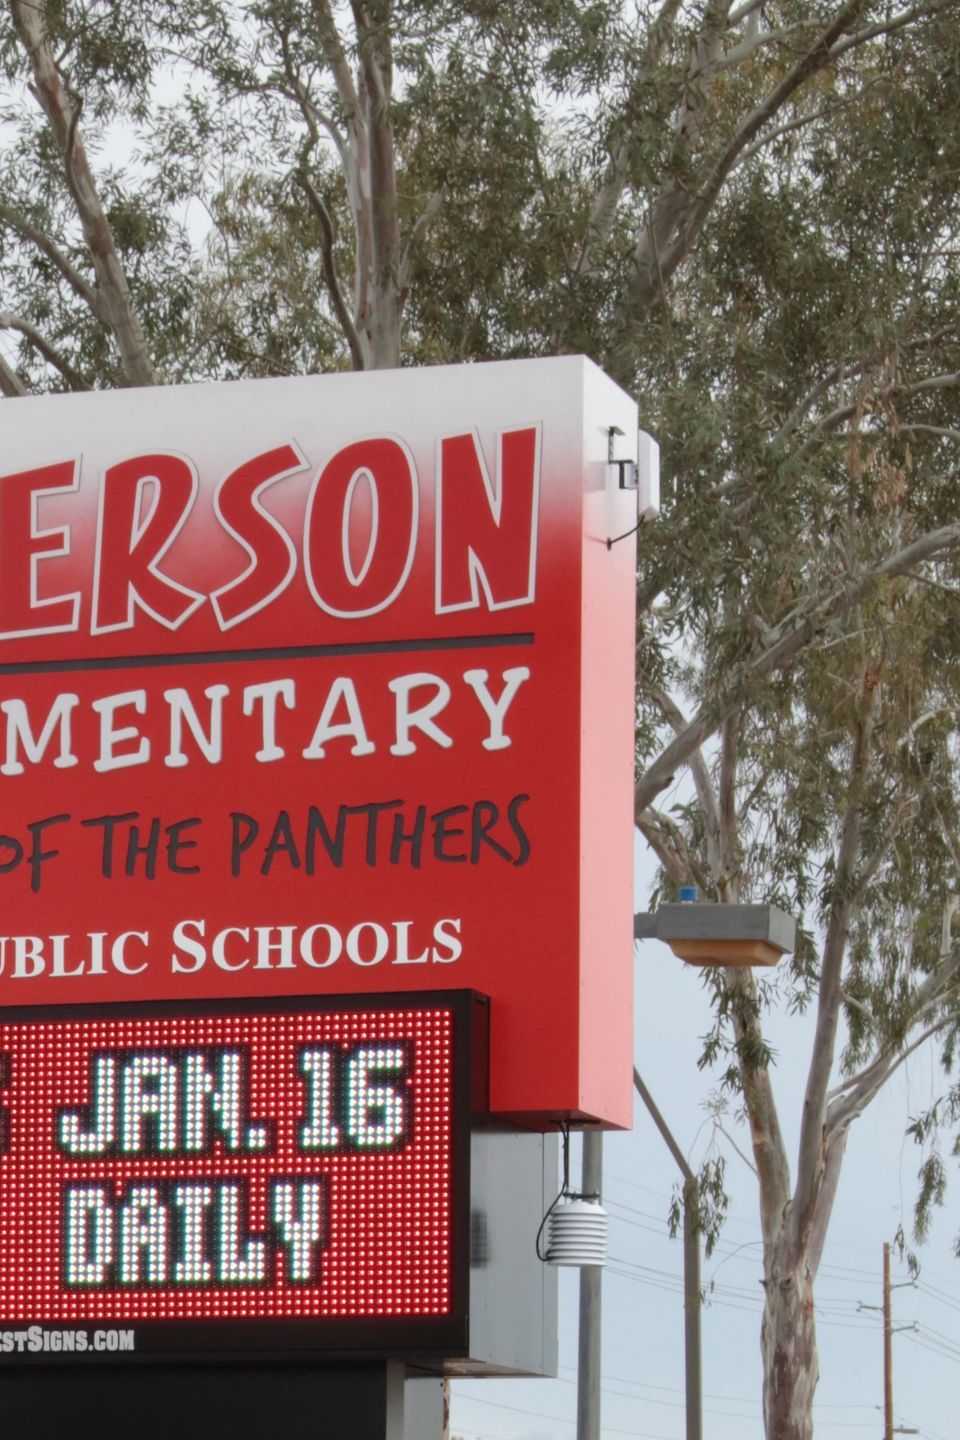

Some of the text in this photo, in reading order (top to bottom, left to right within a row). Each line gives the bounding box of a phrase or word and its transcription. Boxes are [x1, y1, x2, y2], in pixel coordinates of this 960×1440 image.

[82, 811, 207, 881] THE
[228, 794, 532, 876] PANTHERS
[172, 918, 463, 975] SCHOOLS
[58, 1052, 267, 1154] JAN.
[298, 1047, 407, 1149] 16
[66, 1181, 323, 1284] DAILY
